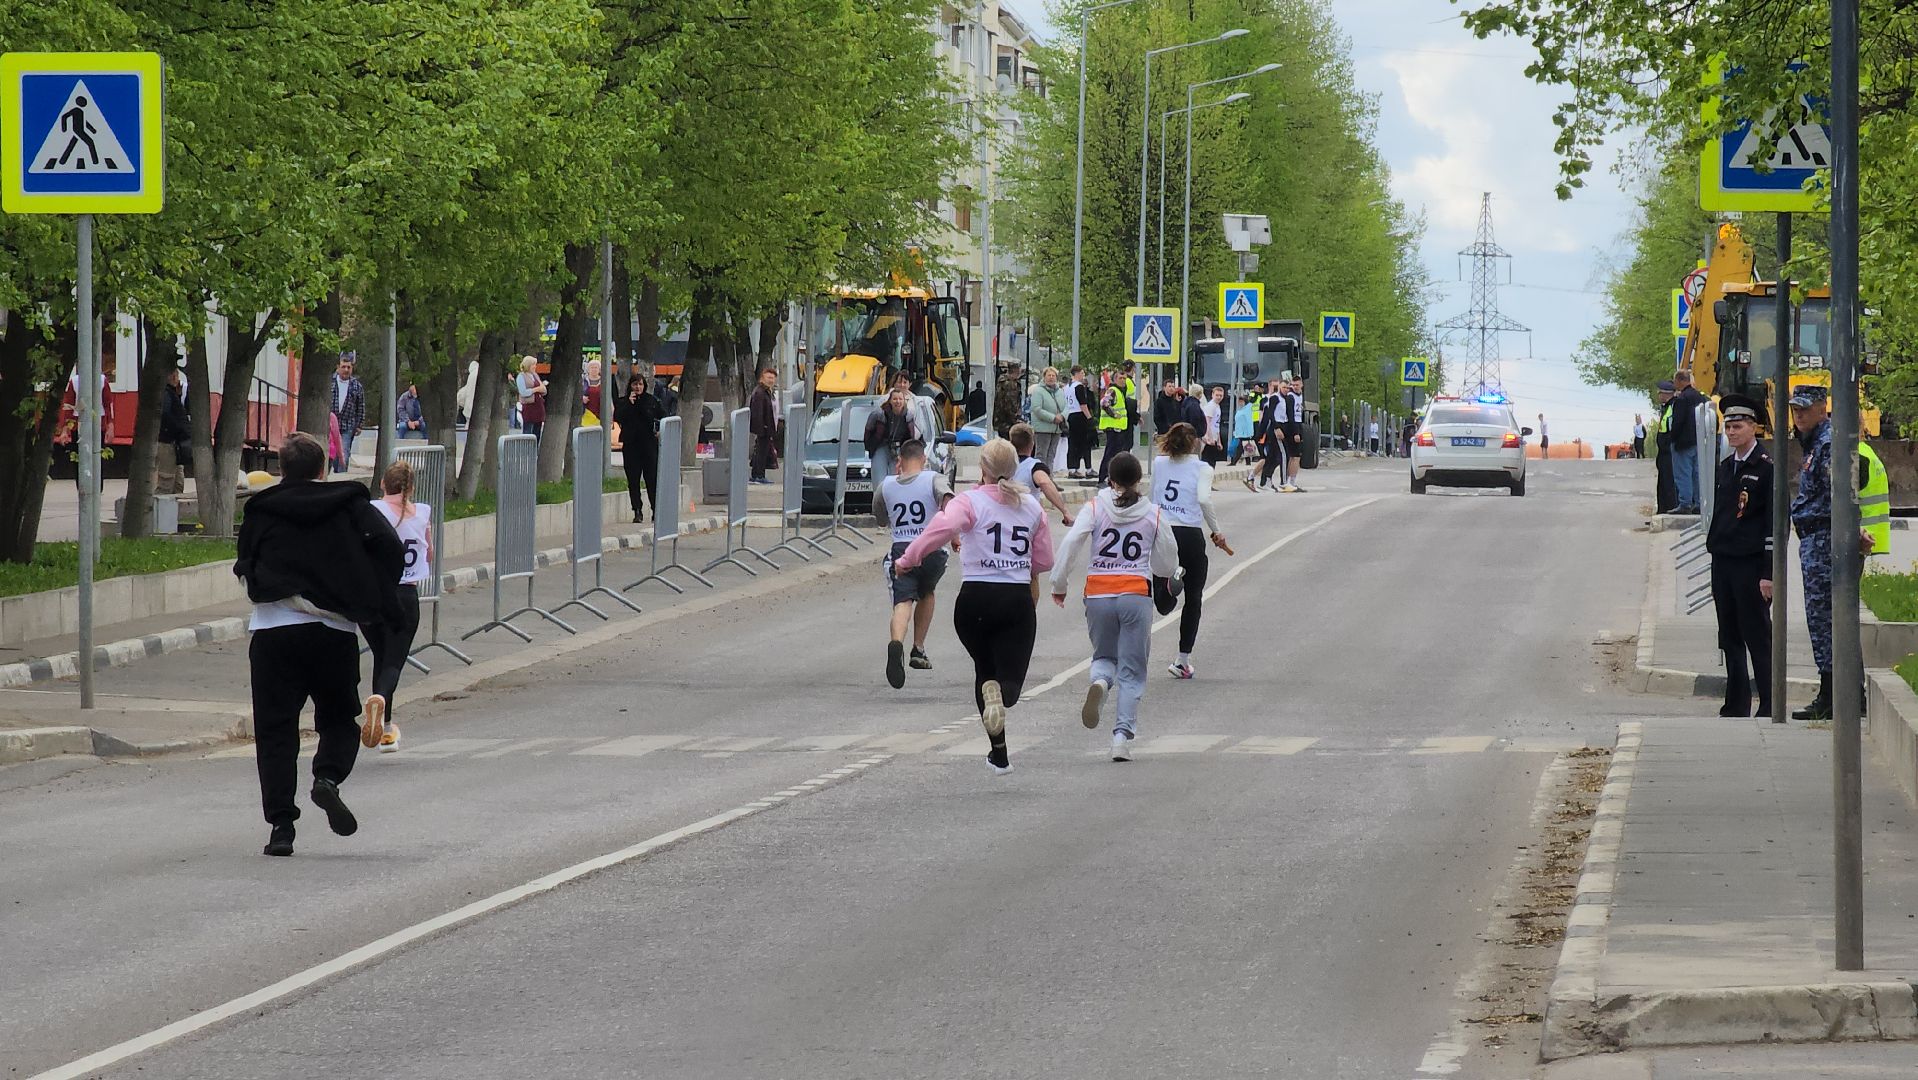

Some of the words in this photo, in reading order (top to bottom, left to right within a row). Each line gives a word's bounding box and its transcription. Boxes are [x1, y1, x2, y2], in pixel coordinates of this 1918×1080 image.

[1164, 479, 1180, 502] 5
[892, 500, 926, 528] 29
[1158, 503, 1186, 515] АШИРА
[986, 522, 1030, 556] 15
[1098, 527, 1143, 562] 26
[980, 558, 1030, 569] КАШИРА
